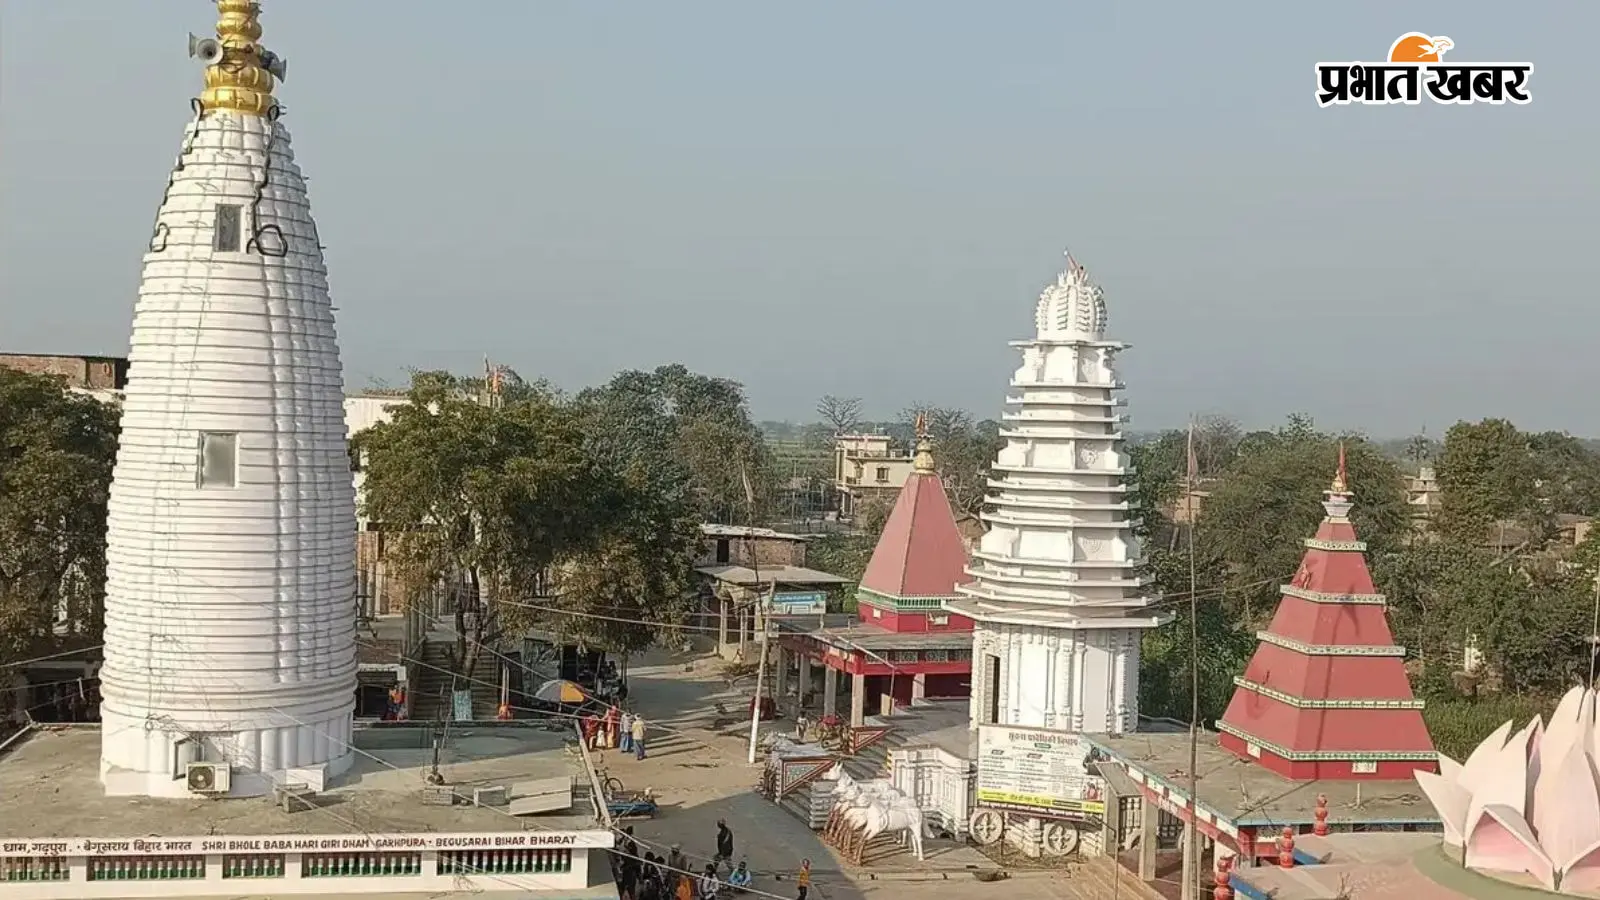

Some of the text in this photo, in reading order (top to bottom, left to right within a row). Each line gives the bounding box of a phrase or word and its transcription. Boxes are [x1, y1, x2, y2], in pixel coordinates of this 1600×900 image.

[133, 840, 162, 853] बिहार
[164, 841, 193, 852] भारत
[202, 835, 578, 851] SHRI BHOLE BABA HARI GIRI DHAM GARHPURA BEGUSARAI BIHAR BHARAT
